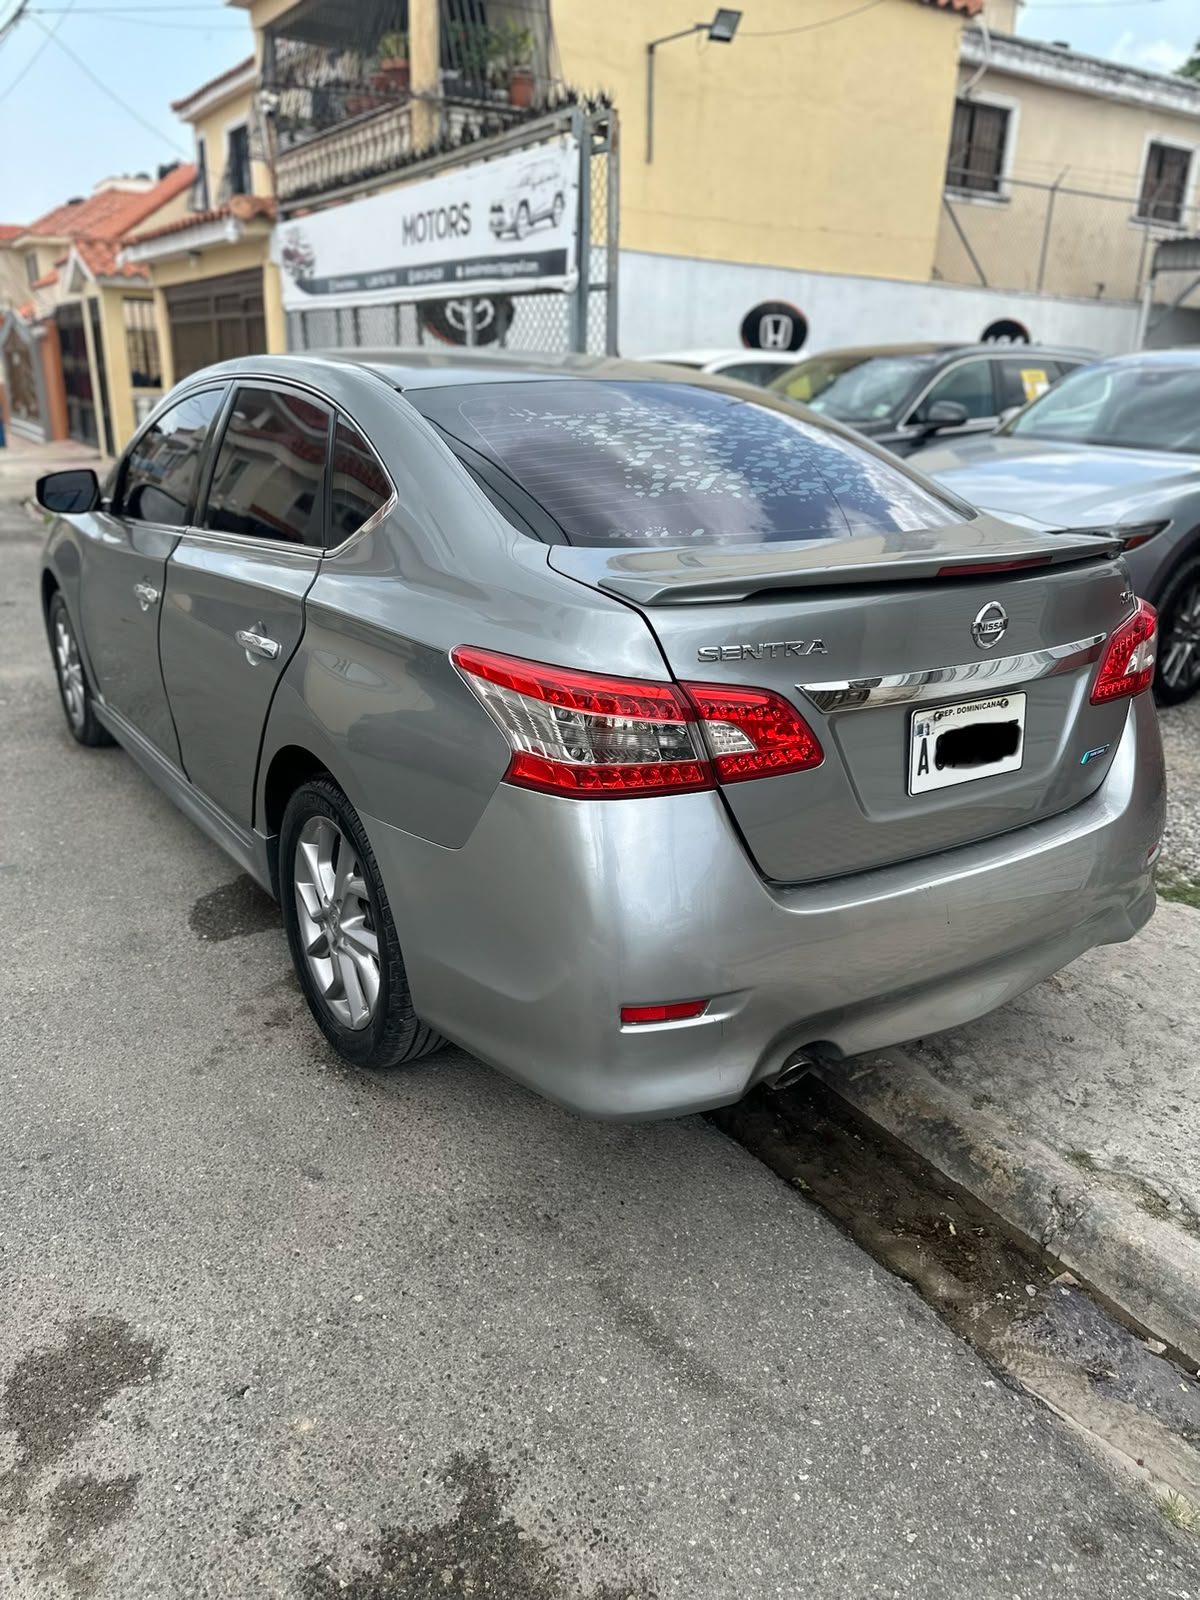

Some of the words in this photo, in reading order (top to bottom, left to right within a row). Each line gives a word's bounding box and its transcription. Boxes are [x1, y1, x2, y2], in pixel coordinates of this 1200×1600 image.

[402, 202, 471, 245] MOTORS
[698, 639, 828, 662] SENTRA
[957, 700, 1002, 715] DOMINICANA
